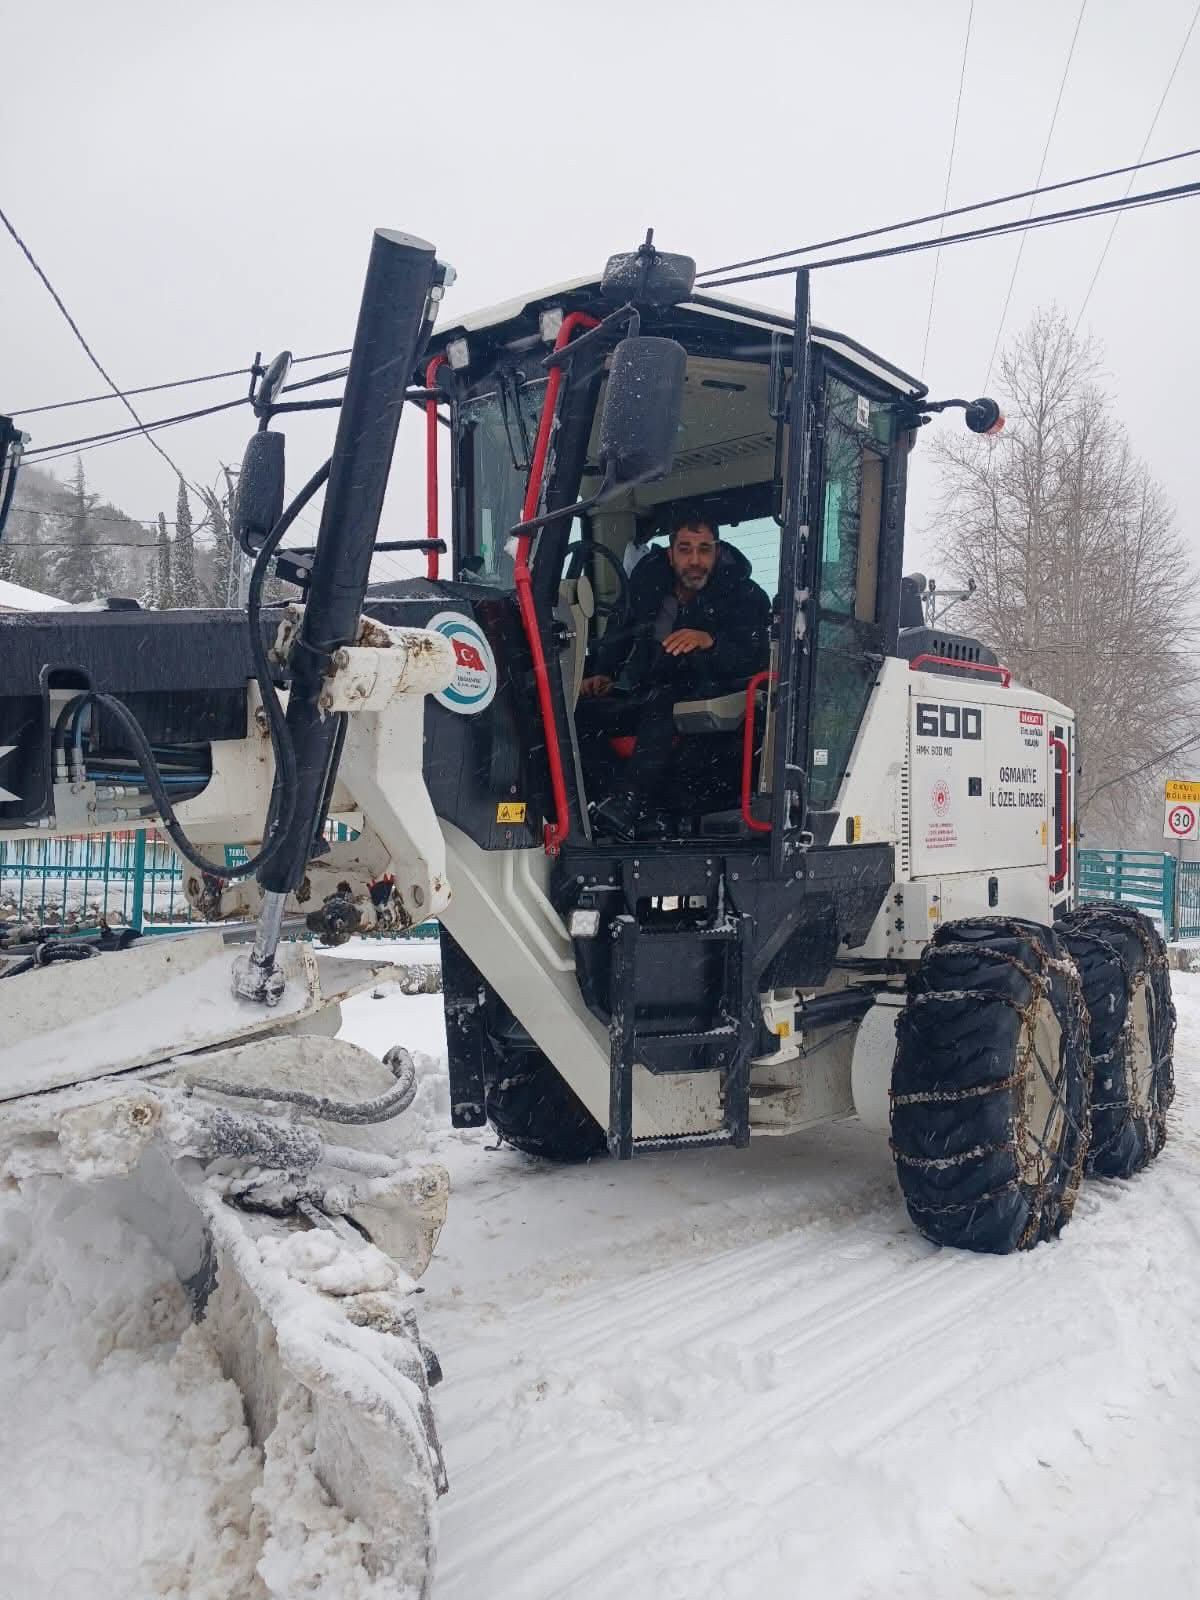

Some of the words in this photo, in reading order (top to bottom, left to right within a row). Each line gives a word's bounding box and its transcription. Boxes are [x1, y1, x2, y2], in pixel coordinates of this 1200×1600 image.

[917, 703, 982, 740] 600
[1000, 765, 1037, 783] OSMANİYE
[989, 786, 996, 808] İL
[998, 787, 1017, 808] ÖZEL
[1018, 788, 1046, 809] İDARESİ
[1174, 813, 1190, 827] 30
